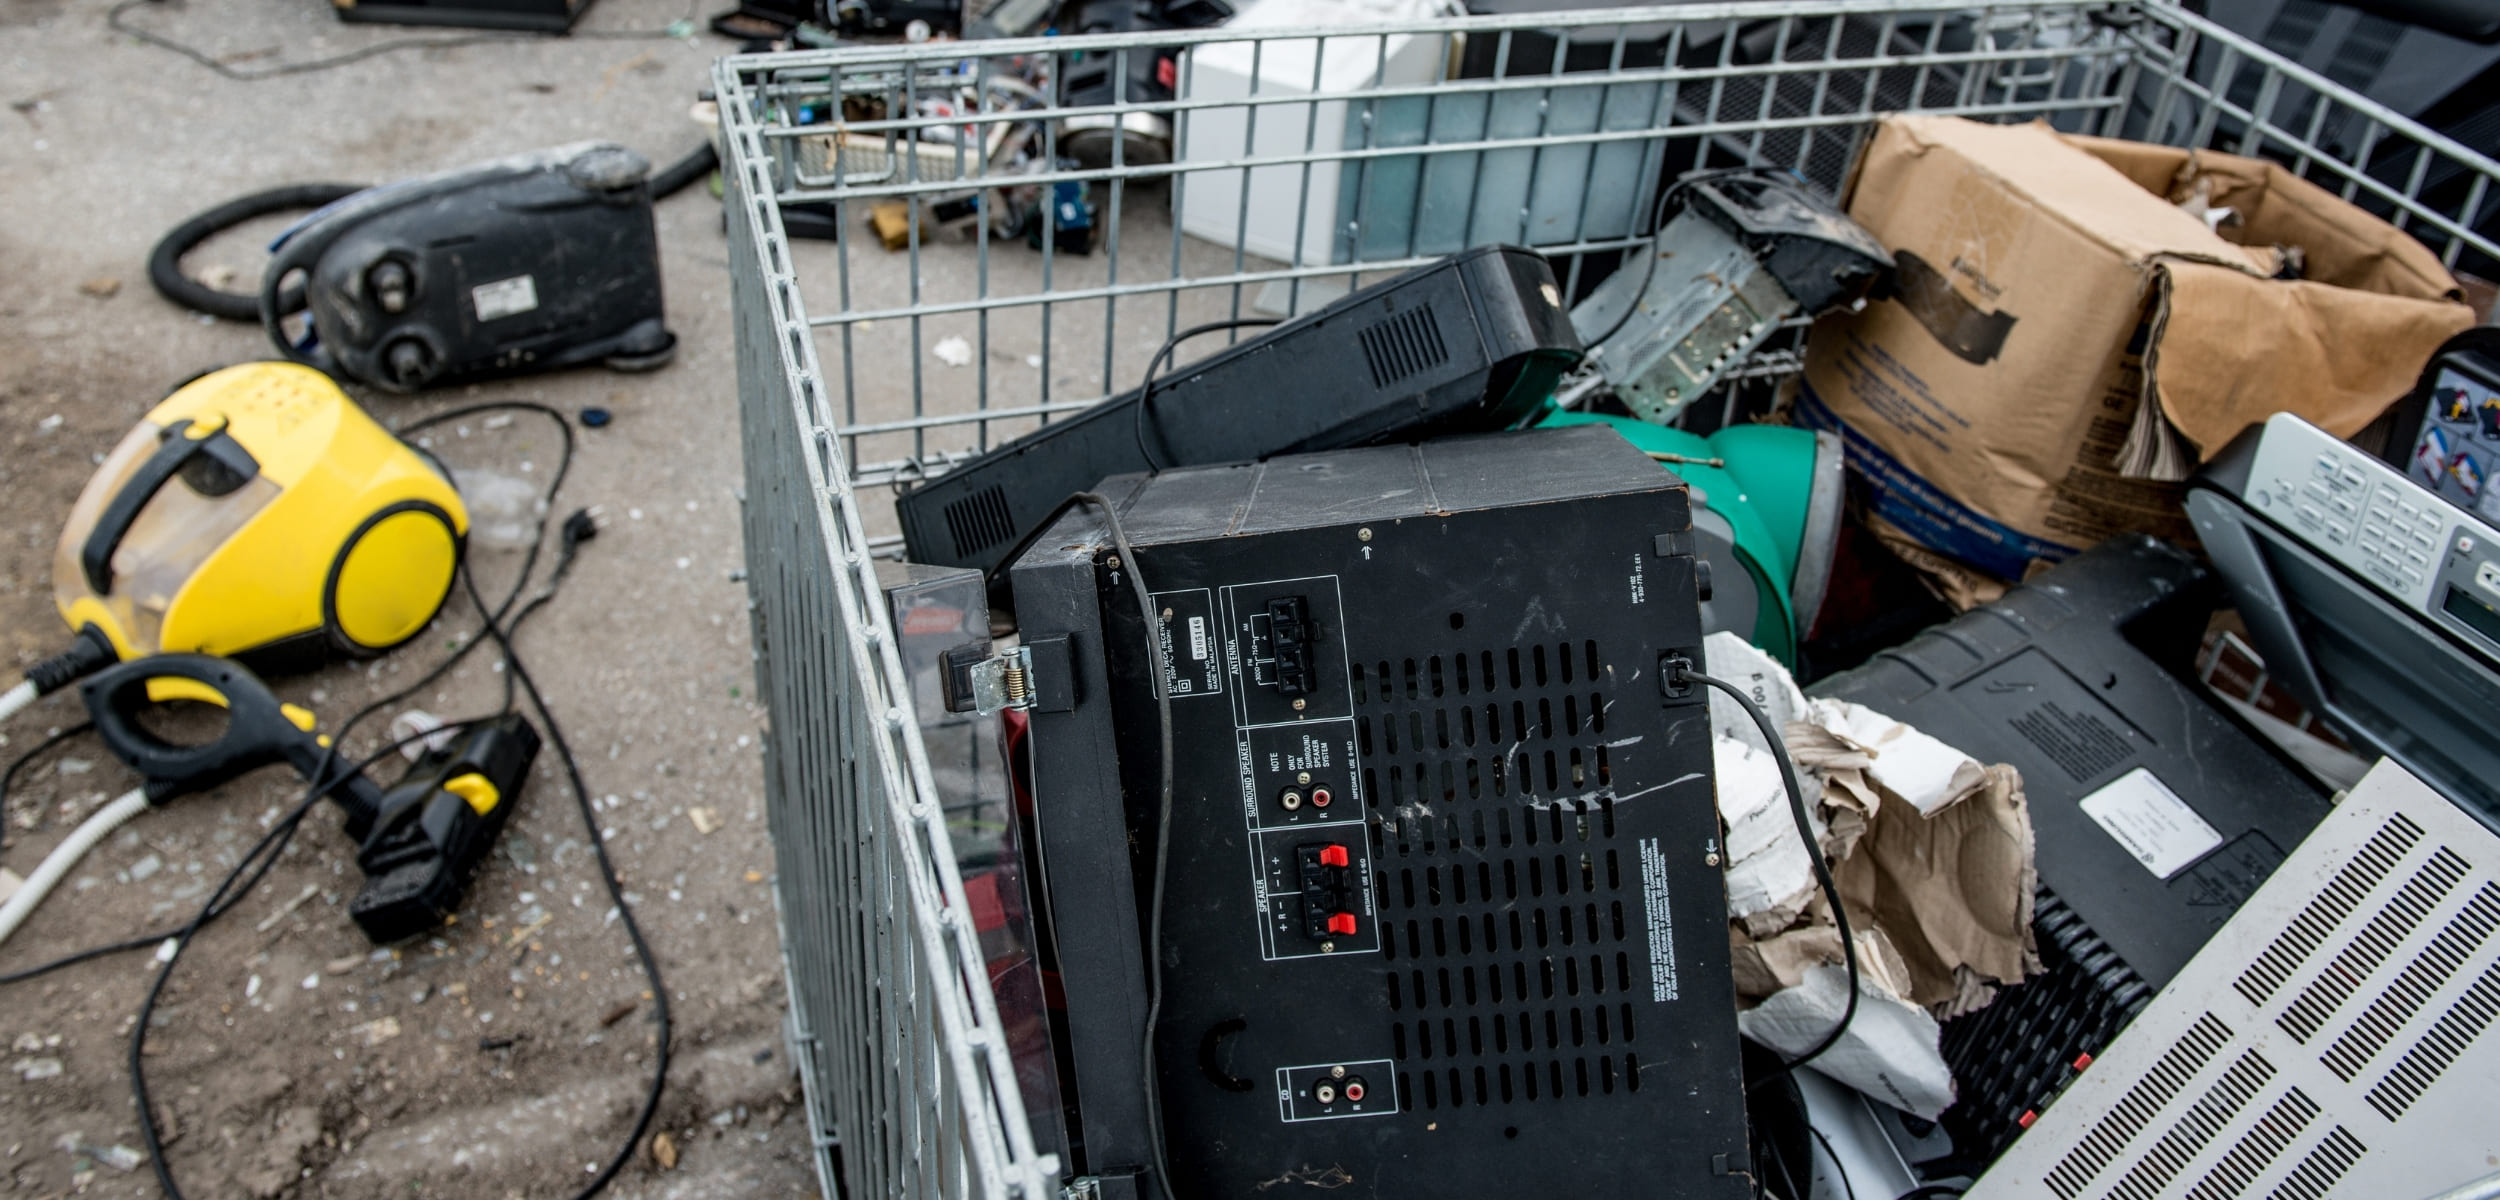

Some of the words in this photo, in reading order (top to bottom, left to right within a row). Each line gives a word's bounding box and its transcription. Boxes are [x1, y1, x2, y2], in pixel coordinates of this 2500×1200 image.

[1158, 618, 1167, 648] RECEIVER
[1243, 623, 1249, 631] AM
[1207, 636, 1215, 663] MALAYSIA
[1228, 639, 1239, 675] ANTENNA
[1240, 741, 1251, 775] SPEAKER
[1270, 752, 1280, 772] NOTE
[1287, 754, 1296, 770] ONLY
[1303, 734, 1313, 769] SURROUND
[1312, 739, 1321, 768] SPEAKER
[1320, 742, 1330, 767] SYSTEM
[1244, 777, 1256, 817] SURROUND
[1350, 771, 1359, 799] IMPEDANCE
[1652, 838, 1660, 875] TRADEMARKS
[1256, 879, 1267, 912] SPEAKER
[1363, 888, 1372, 916] IMPEDANCE
[1644, 885, 1653, 929] MANUFACTURED
[1654, 921, 1662, 963] LABORATORIES
[1667, 928, 1675, 970] LABORATORIES
[1281, 1089, 1289, 1100] CD
